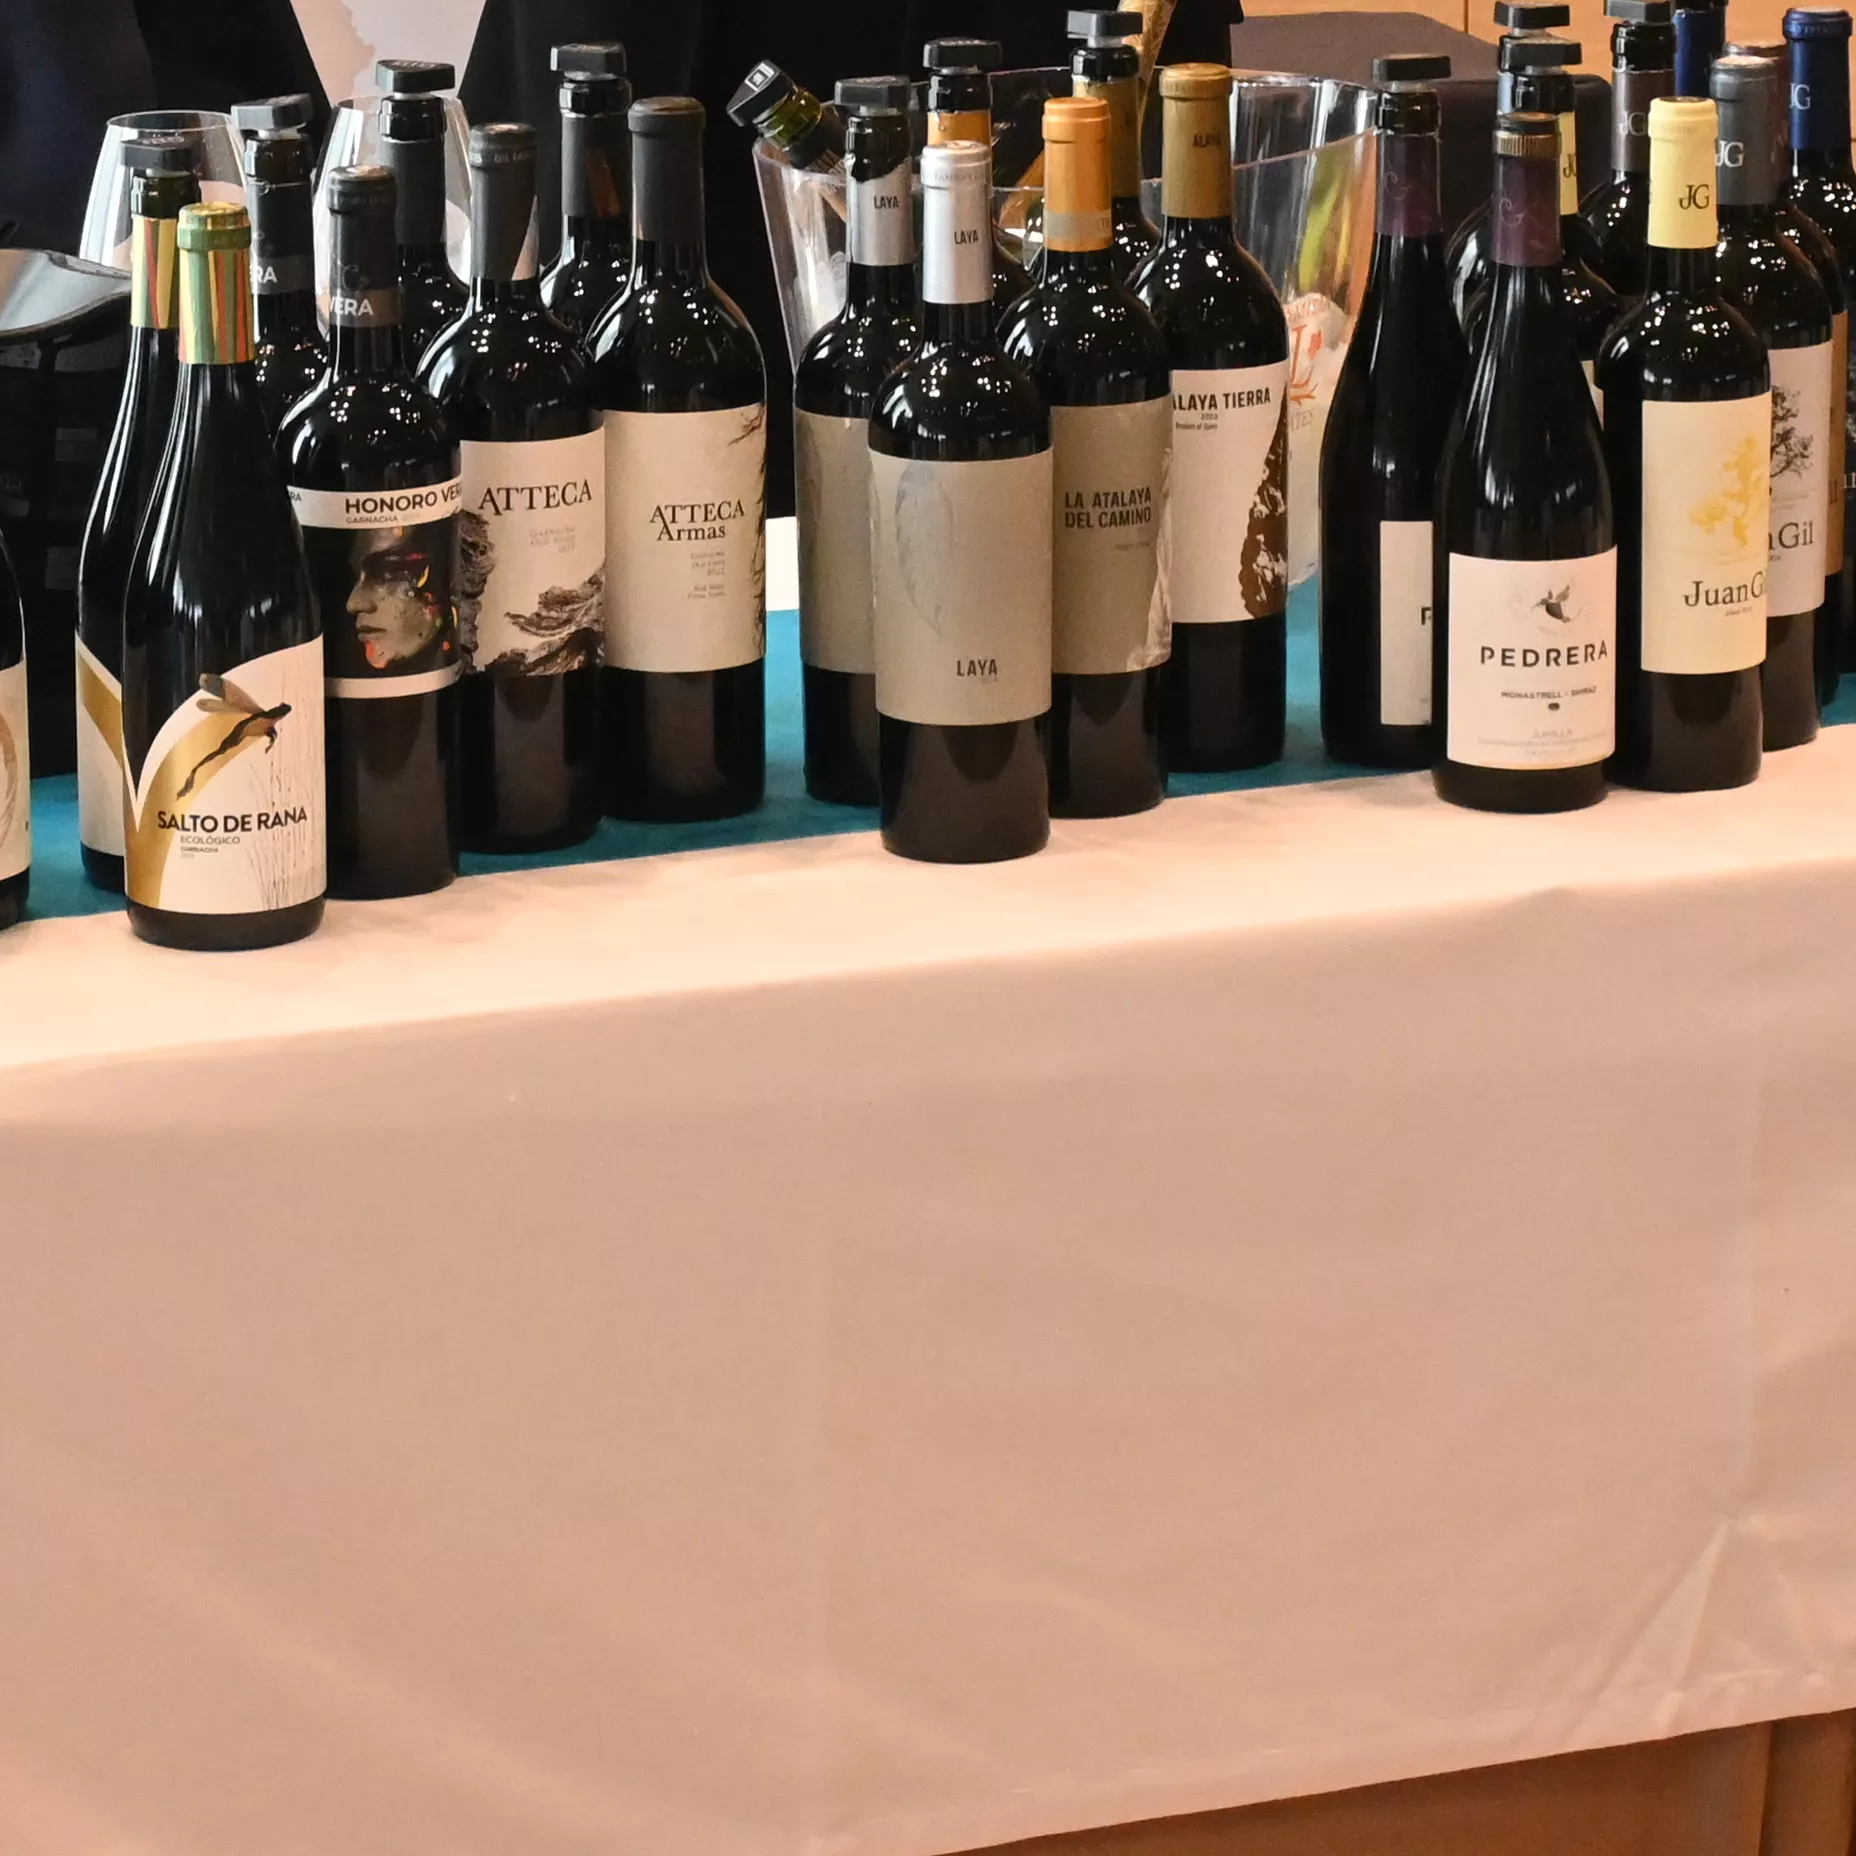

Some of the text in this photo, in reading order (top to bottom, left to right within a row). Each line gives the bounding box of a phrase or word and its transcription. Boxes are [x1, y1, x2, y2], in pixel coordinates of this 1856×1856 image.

[1789, 84, 1811, 111] JG
[1716, 140, 1744, 168] JG
[874, 195, 899, 210] LAYA
[1679, 184, 1710, 210] JG
[954, 229, 979, 245] LAYA
[1223, 387, 1271, 410] TIERRA
[345, 481, 463, 515] HONORO VER
[478, 478, 592, 517] ATTECA
[1065, 487, 1151, 509] LA ATALAYA
[649, 498, 744, 526] ATTECA
[1065, 507, 1151, 529] DEL CAMINO
[656, 523, 726, 542] Armas
[1480, 640, 1608, 667] PEDRERA
[957, 658, 998, 677] LAYA
[1501, 691, 1562, 700] MONASTRELL
[157, 805, 308, 834] SALTO DE RANA
[180, 833, 242, 846] ECOLÓGICO
